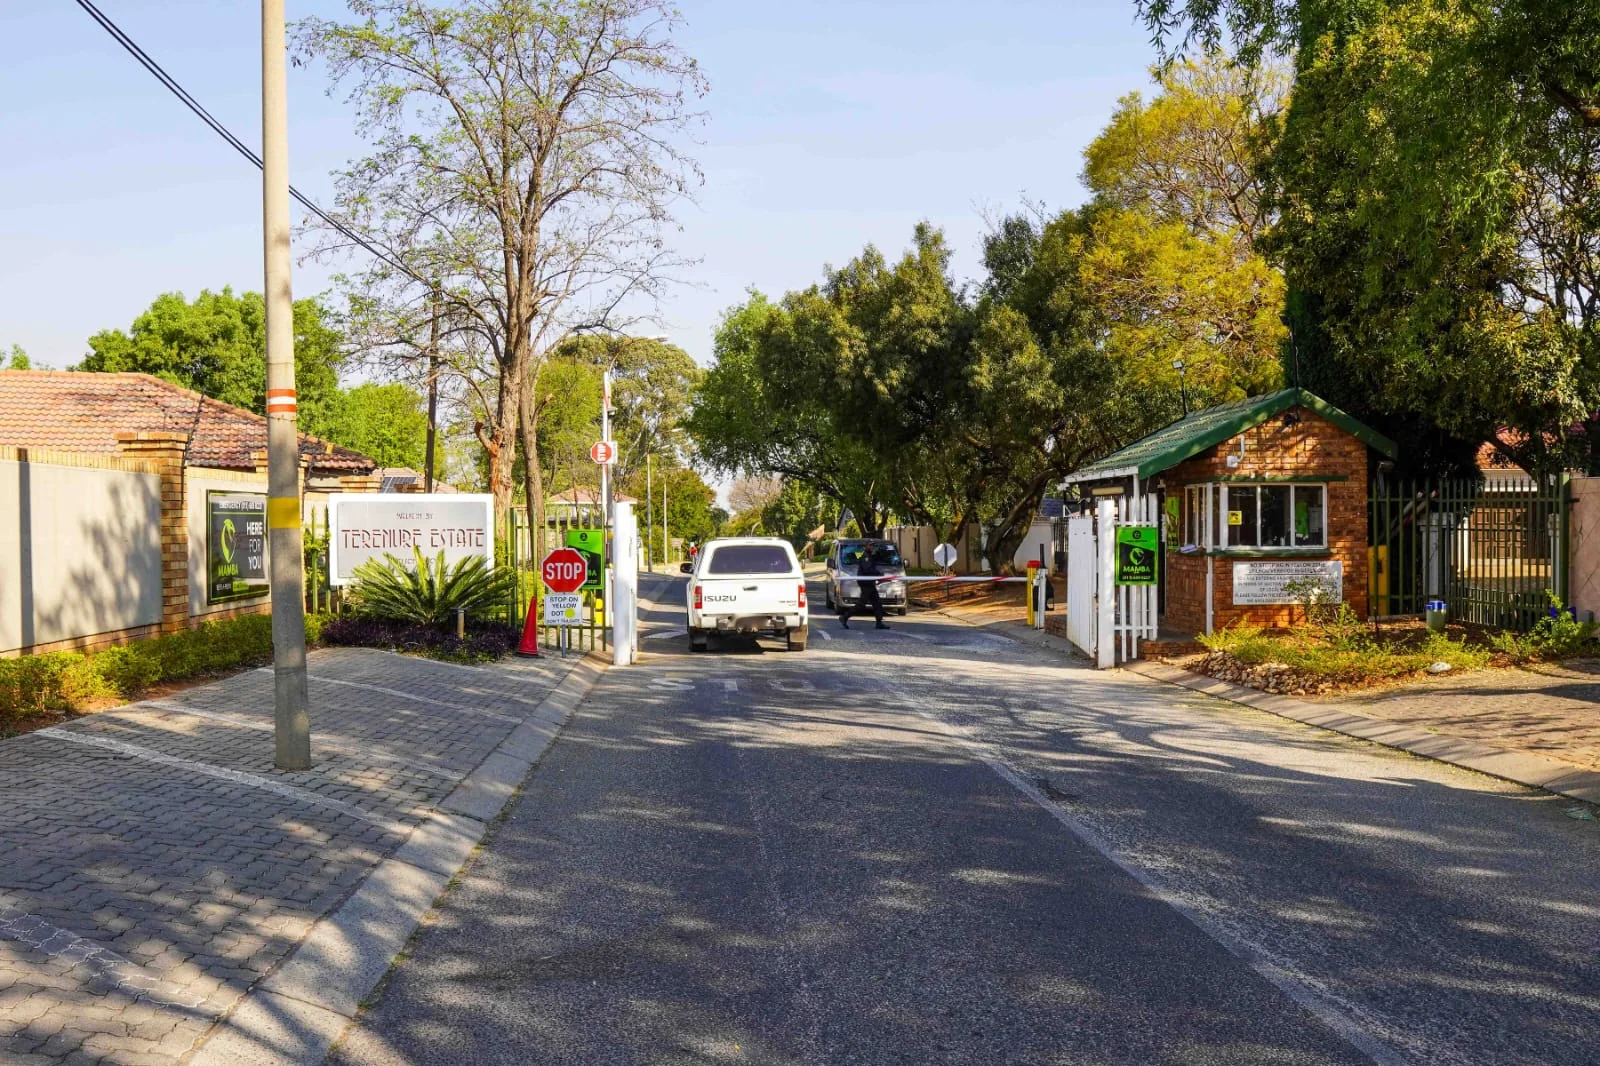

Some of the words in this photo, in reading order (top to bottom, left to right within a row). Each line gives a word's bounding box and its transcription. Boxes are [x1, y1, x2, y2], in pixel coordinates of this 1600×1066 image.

[246, 521, 263, 536] HERE
[248, 538, 261, 553] FOR
[341, 528, 422, 549] TERENURE
[430, 528, 485, 548] ESTATE
[217, 563, 239, 576] MAMBA
[247, 555, 262, 570] YOU
[1122, 565, 1150, 573] MAMBA
[546, 562, 582, 580] STOP
